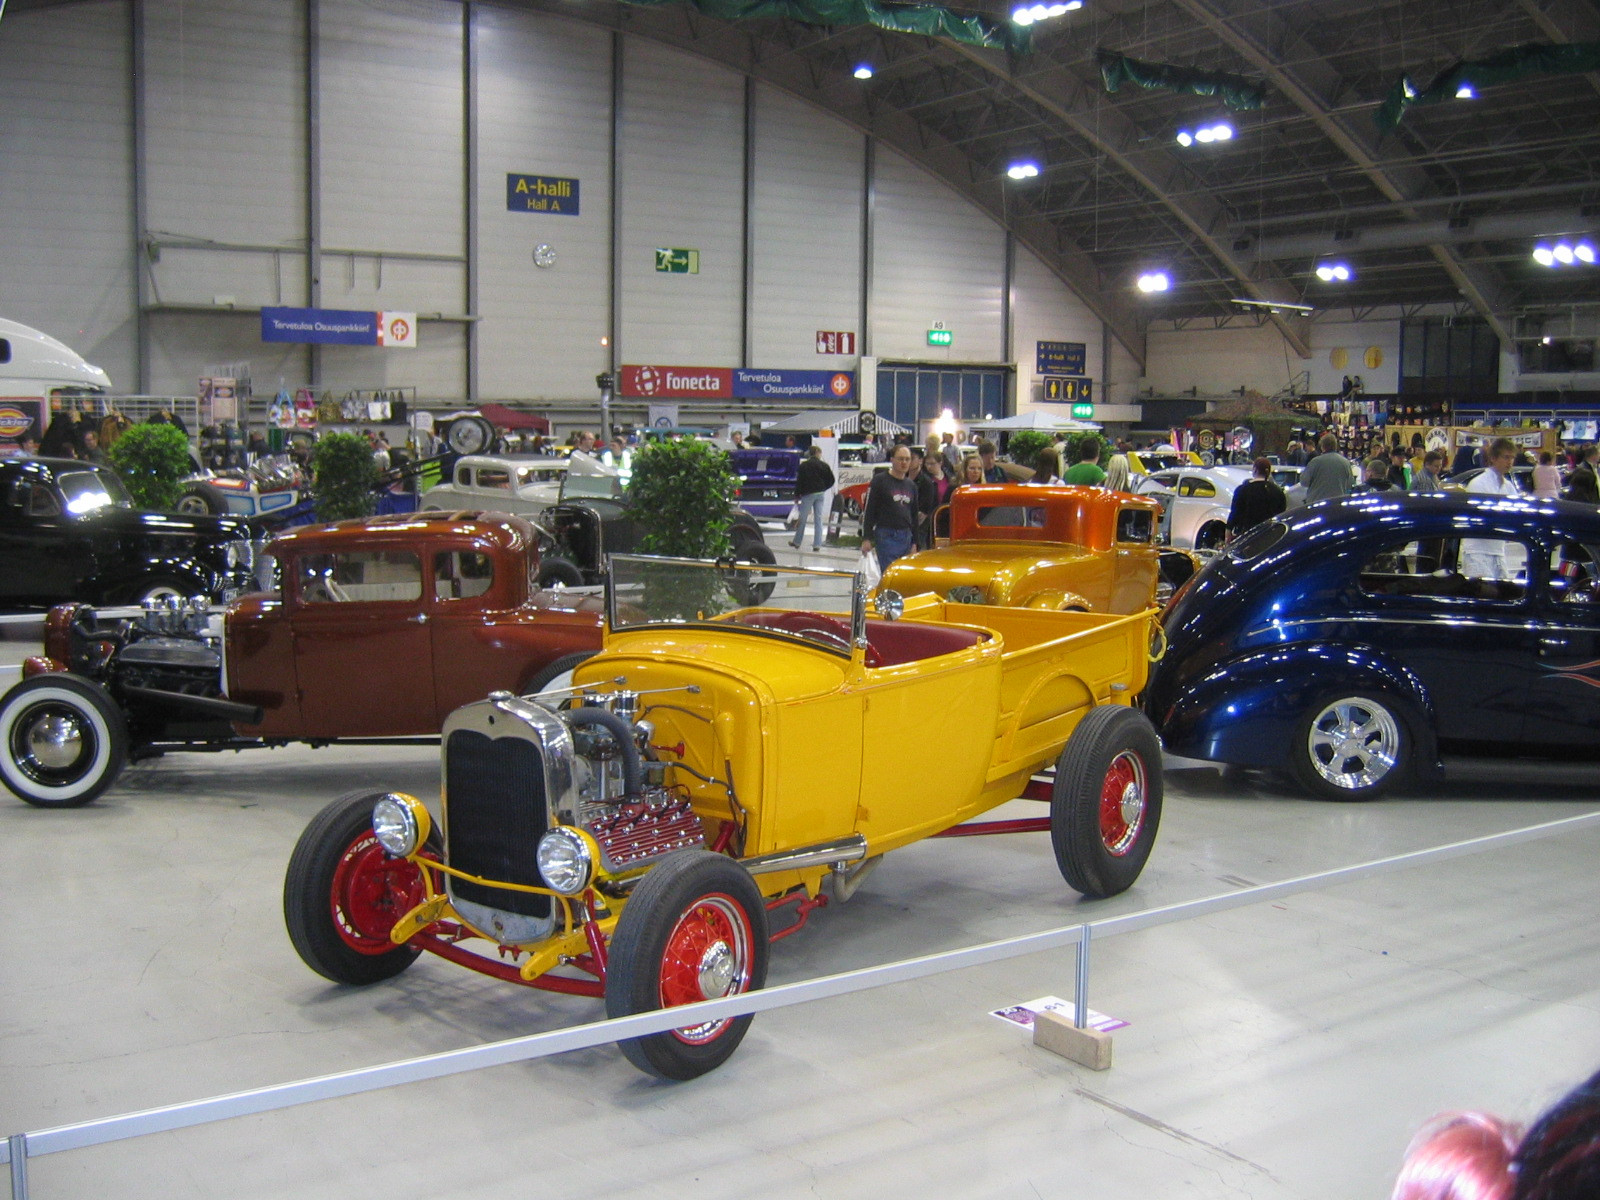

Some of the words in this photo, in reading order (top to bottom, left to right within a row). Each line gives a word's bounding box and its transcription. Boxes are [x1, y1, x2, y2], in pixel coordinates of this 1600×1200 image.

[515, 179, 571, 197] A-halli
[527, 199, 547, 211] Hall
[551, 200, 560, 211] A
[273, 320, 313, 331] Tervetuloa
[666, 372, 720, 390] fonecta
[738, 372, 782, 383] Tervetuloa
[763, 383, 824, 396] Osuuspankkiin!
